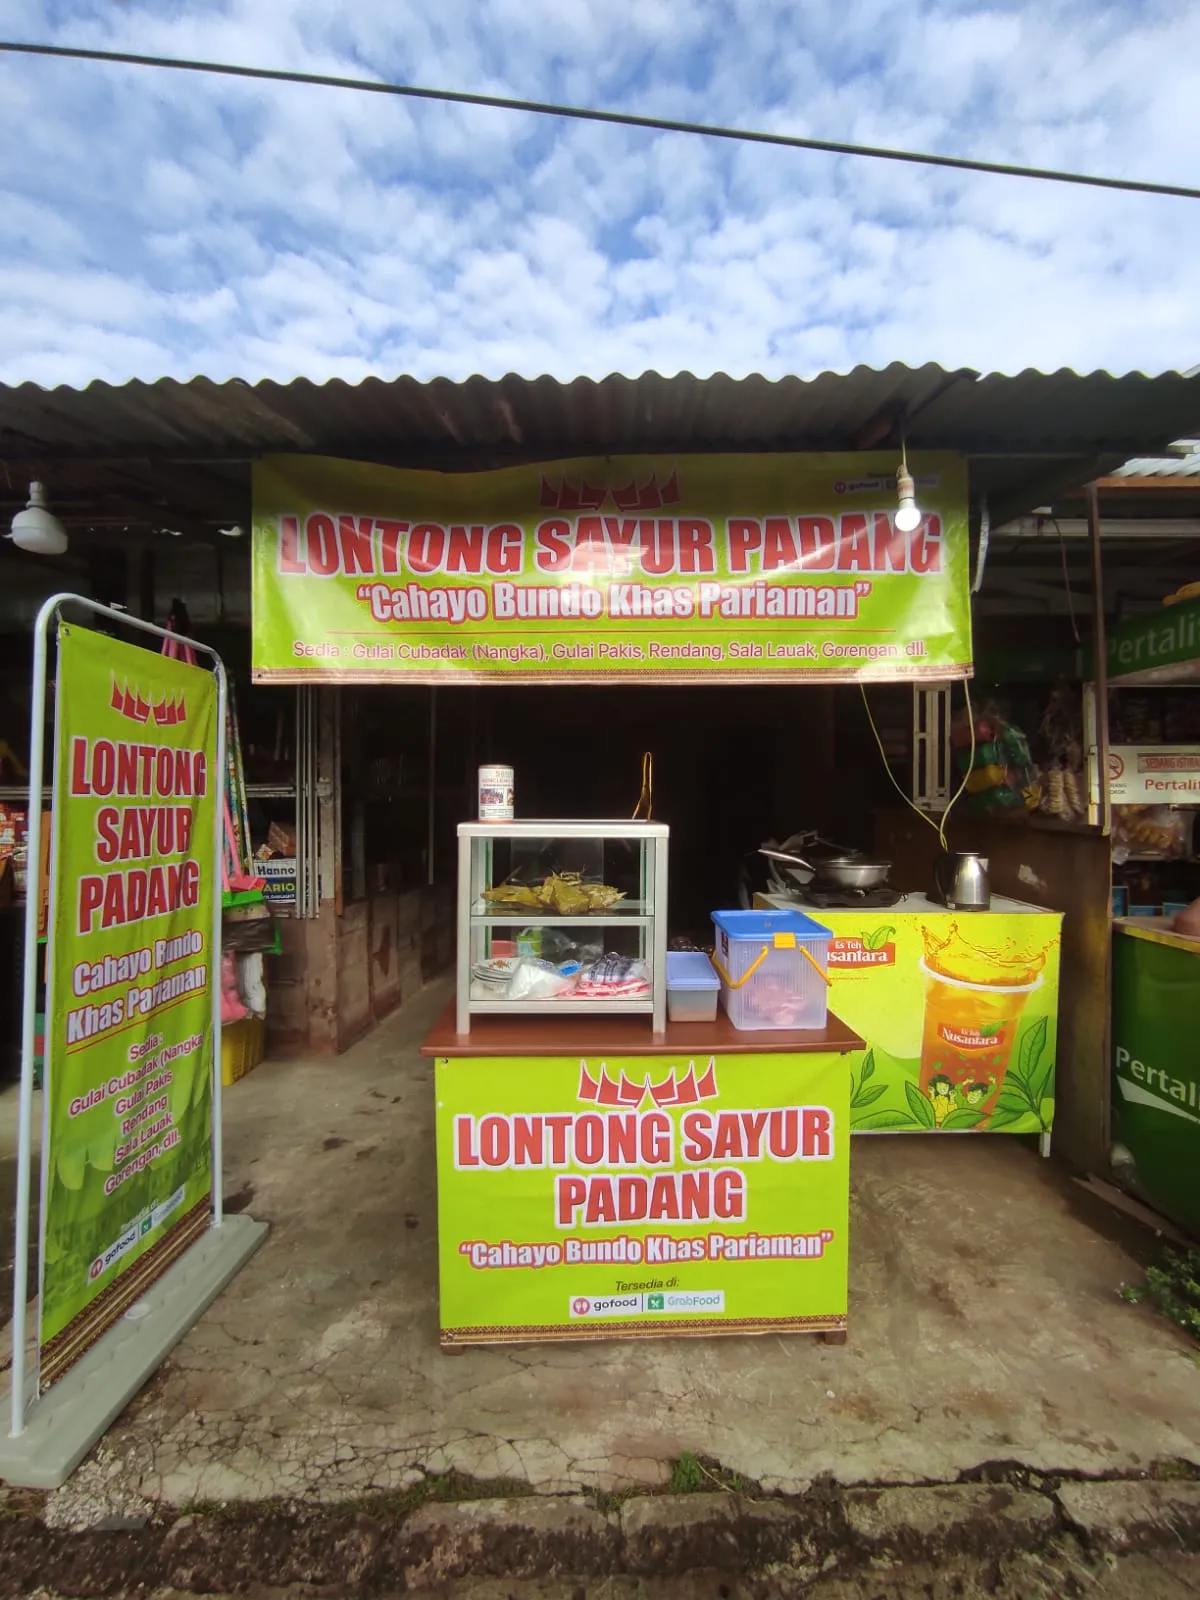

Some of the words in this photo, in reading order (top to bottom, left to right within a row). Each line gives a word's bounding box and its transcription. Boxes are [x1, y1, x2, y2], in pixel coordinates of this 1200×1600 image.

[279, 513, 524, 576] LONTONG
[535, 515, 715, 576] SAYUR
[727, 510, 945, 574] PADANG
[491, 580, 604, 622] Bundo
[607, 581, 695, 620] Khas
[352, 643, 394, 659] Gulai
[398, 644, 468, 659] Cubadak
[472, 645, 549, 662] (Nangka),
[552, 643, 594, 659] Gulai
[598, 642, 645, 660] Pakis,
[649, 642, 725, 660] Rendang,
[728, 642, 762, 658] Sala
[766, 642, 819, 659] Lauak,
[905, 641, 929, 656] dll.
[1106, 612, 1200, 665] ertali
[70, 736, 208, 797] LONTONG
[96, 806, 193, 864] SAYUR
[257, 865, 295, 875] Hanno
[264, 883, 296, 892] ARIO
[77, 860, 200, 936] PADANG
[72, 947, 150, 998] Cahayo
[154, 929, 204, 966] Bundo
[827, 950, 888, 963] santara
[66, 997, 124, 1046] Khas
[126, 964, 207, 1021] Pariaman
[942, 1026, 999, 1046] Nusantara
[69, 1084, 105, 1117] Gulai
[107, 1057, 158, 1096] Cubadak
[115, 1085, 145, 1116] Gulai
[145, 1069, 173, 1096] Pakis
[1116, 1045, 1200, 1110] Pertal
[115, 1137, 139, 1164] Sala
[140, 1112, 173, 1144] Lauak
[121, 1093, 169, 1137] Rendang
[454, 1109, 674, 1171] LONTONG
[679, 1105, 835, 1163] SAYUR
[104, 1143, 162, 1195] Gorengan,
[162, 1129, 183, 1150] dll.
[554, 1167, 747, 1229] PADANG
[104, 1230, 136, 1265] gofood
[459, 1240, 562, 1271] “Cahayo
[562, 1234, 643, 1267] Bundo
[644, 1233, 706, 1266] Khas
[706, 1229, 835, 1262] Pariaman”
[593, 1297, 638, 1312] gofood
[667, 1294, 721, 1307] GrabFood
[615, 1279, 663, 1292] Tersedia
